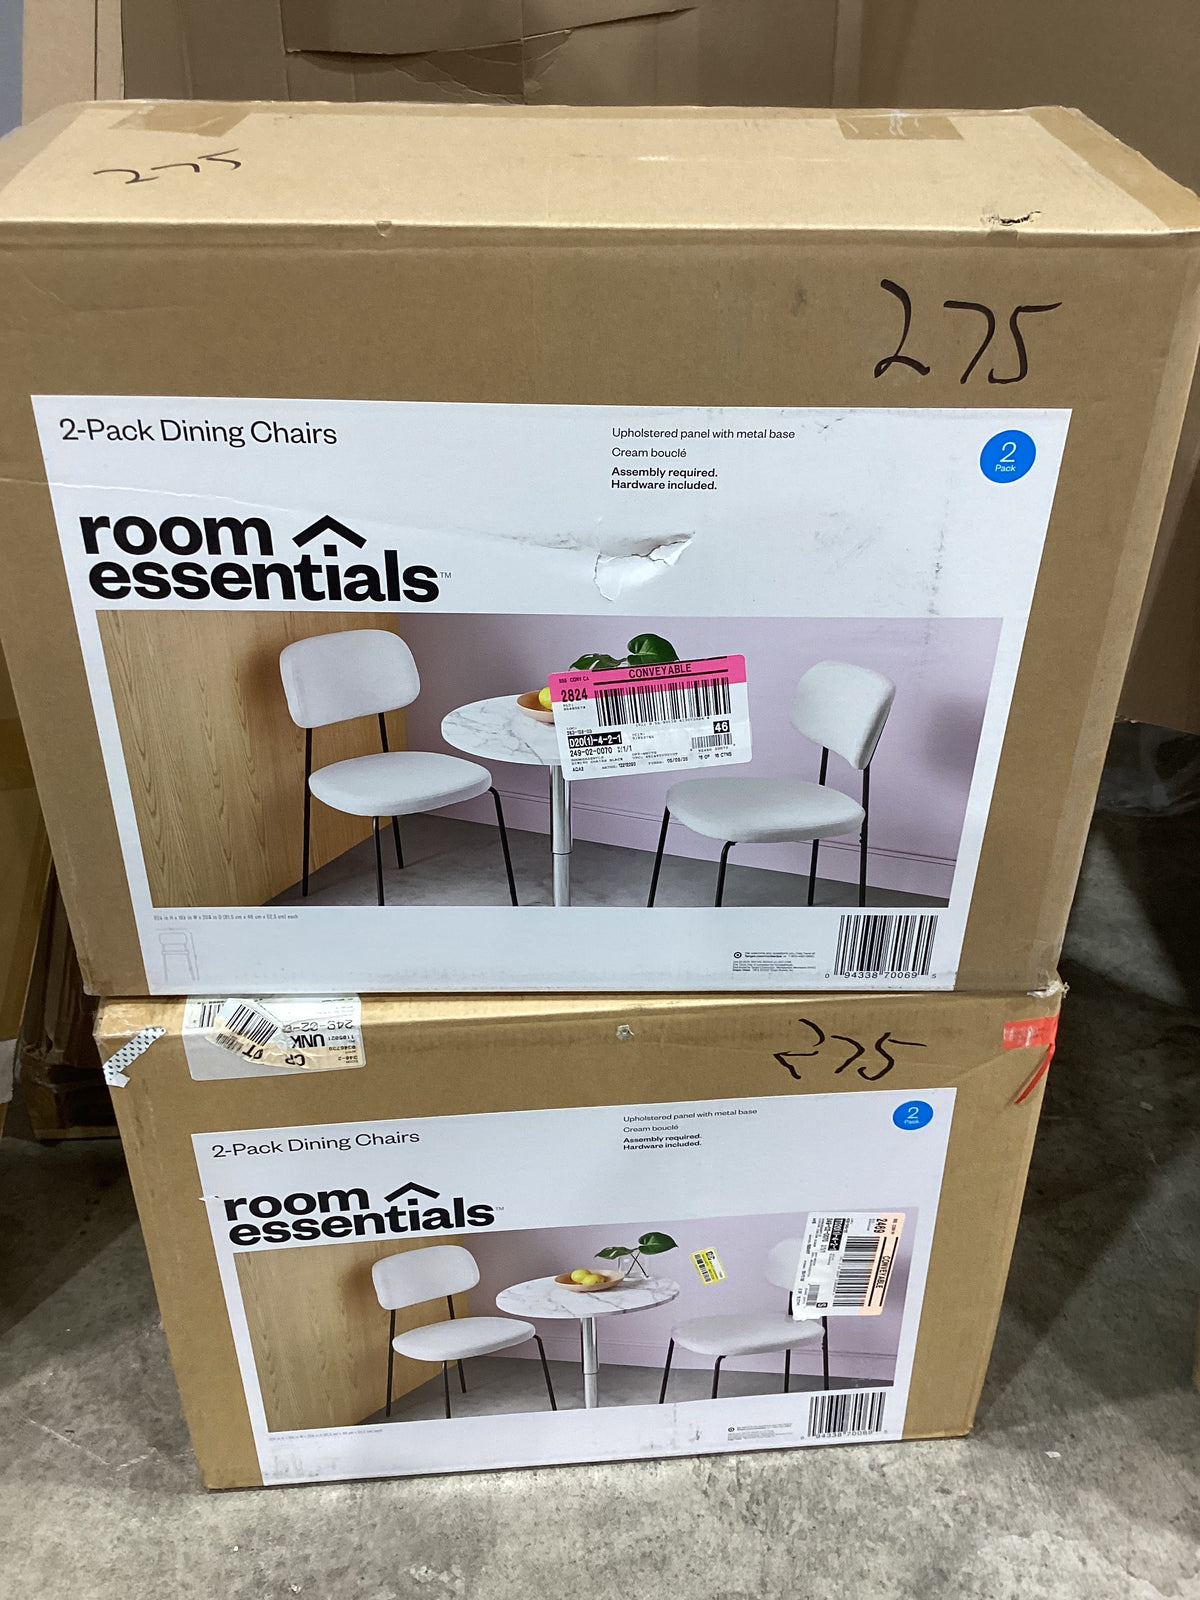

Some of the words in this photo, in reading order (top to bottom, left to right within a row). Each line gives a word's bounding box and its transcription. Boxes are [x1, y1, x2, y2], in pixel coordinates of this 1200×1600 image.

[93, 148, 241, 184] 275
[874, 278, 1063, 385] 275
[59, 418, 155, 442] 2-Pack
[159, 419, 246, 448] Dining
[250, 420, 338, 445] Chairs
[612, 427, 679, 440] Upholstered
[680, 428, 710, 441] panel
[712, 428, 735, 439] with
[736, 428, 767, 439] metal
[769, 428, 796, 439] base
[611, 447, 649, 458] Cream
[650, 447, 687, 458] bouclé
[1000, 441, 1017, 463] 2
[611, 466, 666, 479] Assembly
[668, 467, 718, 479] required.
[994, 463, 1016, 473] Pack
[611, 479, 665, 490] Hardware
[667, 480, 718, 490] included.
[79, 515, 274, 557] room
[88, 544, 440, 604] essentials
[628, 663, 692, 679] CONVEYABLE
[561, 688, 588, 702] 2824
[715, 721, 729, 732] 46
[569, 746, 613, 758] 249-02-0070
[844, 971, 878, 979] 94338
[884, 971, 918, 979] 70069
[290, 1033, 326, 1049] UNK
[773, 1018, 927, 1081] 275
[623, 1114, 672, 1123] Upholstered
[673, 1112, 696, 1121] panel
[906, 1106, 919, 1119] 2
[211, 1141, 283, 1158] 2-Pack
[288, 1135, 352, 1153] Dining
[355, 1130, 420, 1146] Chairs
[623, 1136, 664, 1144] Assembly
[665, 1133, 702, 1142] required.
[623, 1142, 664, 1151] Hardware
[664, 1140, 702, 1149] included.
[223, 1187, 370, 1222] room
[229, 1197, 495, 1247] essentials
[875, 1255, 891, 1289] CONVEYABLE
